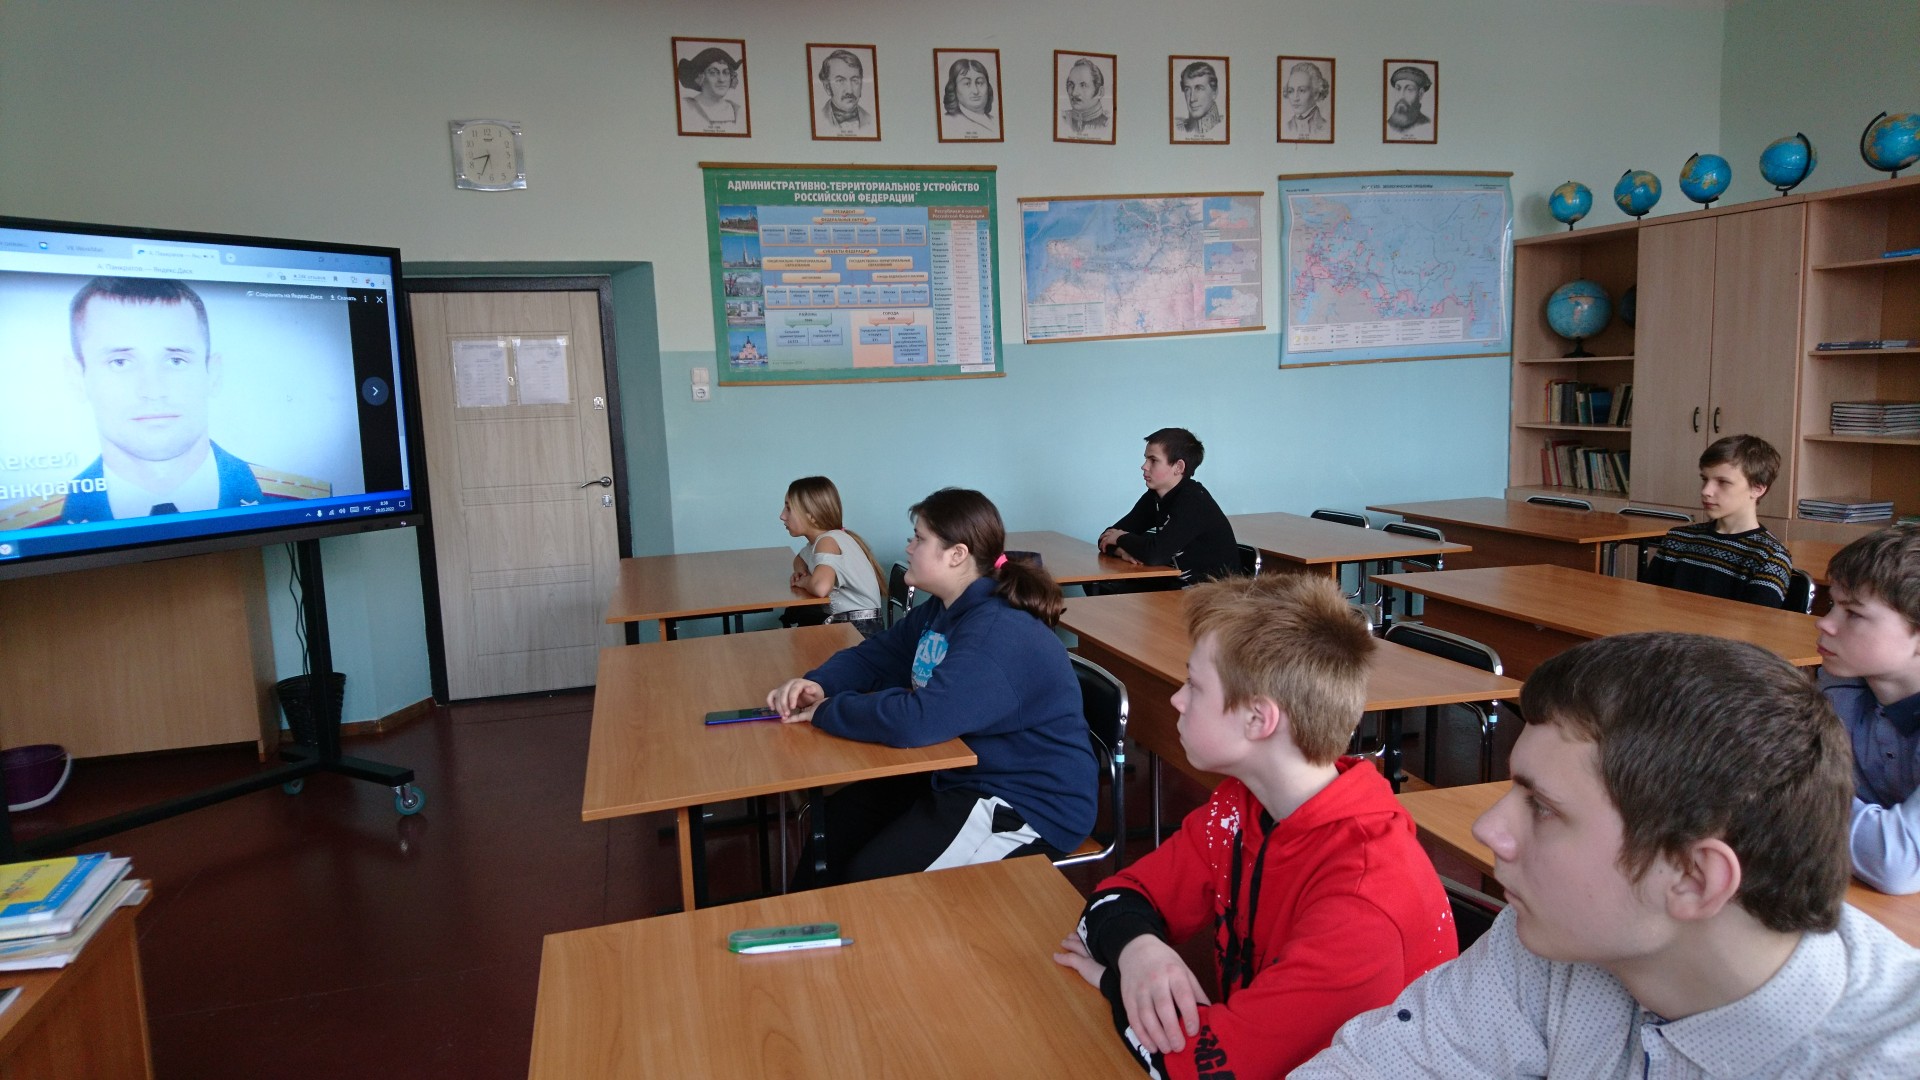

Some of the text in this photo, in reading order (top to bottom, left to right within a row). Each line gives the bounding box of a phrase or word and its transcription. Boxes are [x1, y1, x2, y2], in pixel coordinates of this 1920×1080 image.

[727, 180, 980, 192] АДМИНИСТРАТИВНО-ТЕРРИТОРИАЛЬНОЕ УСТРОЙСТВО
[794, 191, 856, 202] РОССИЙСКОЙ
